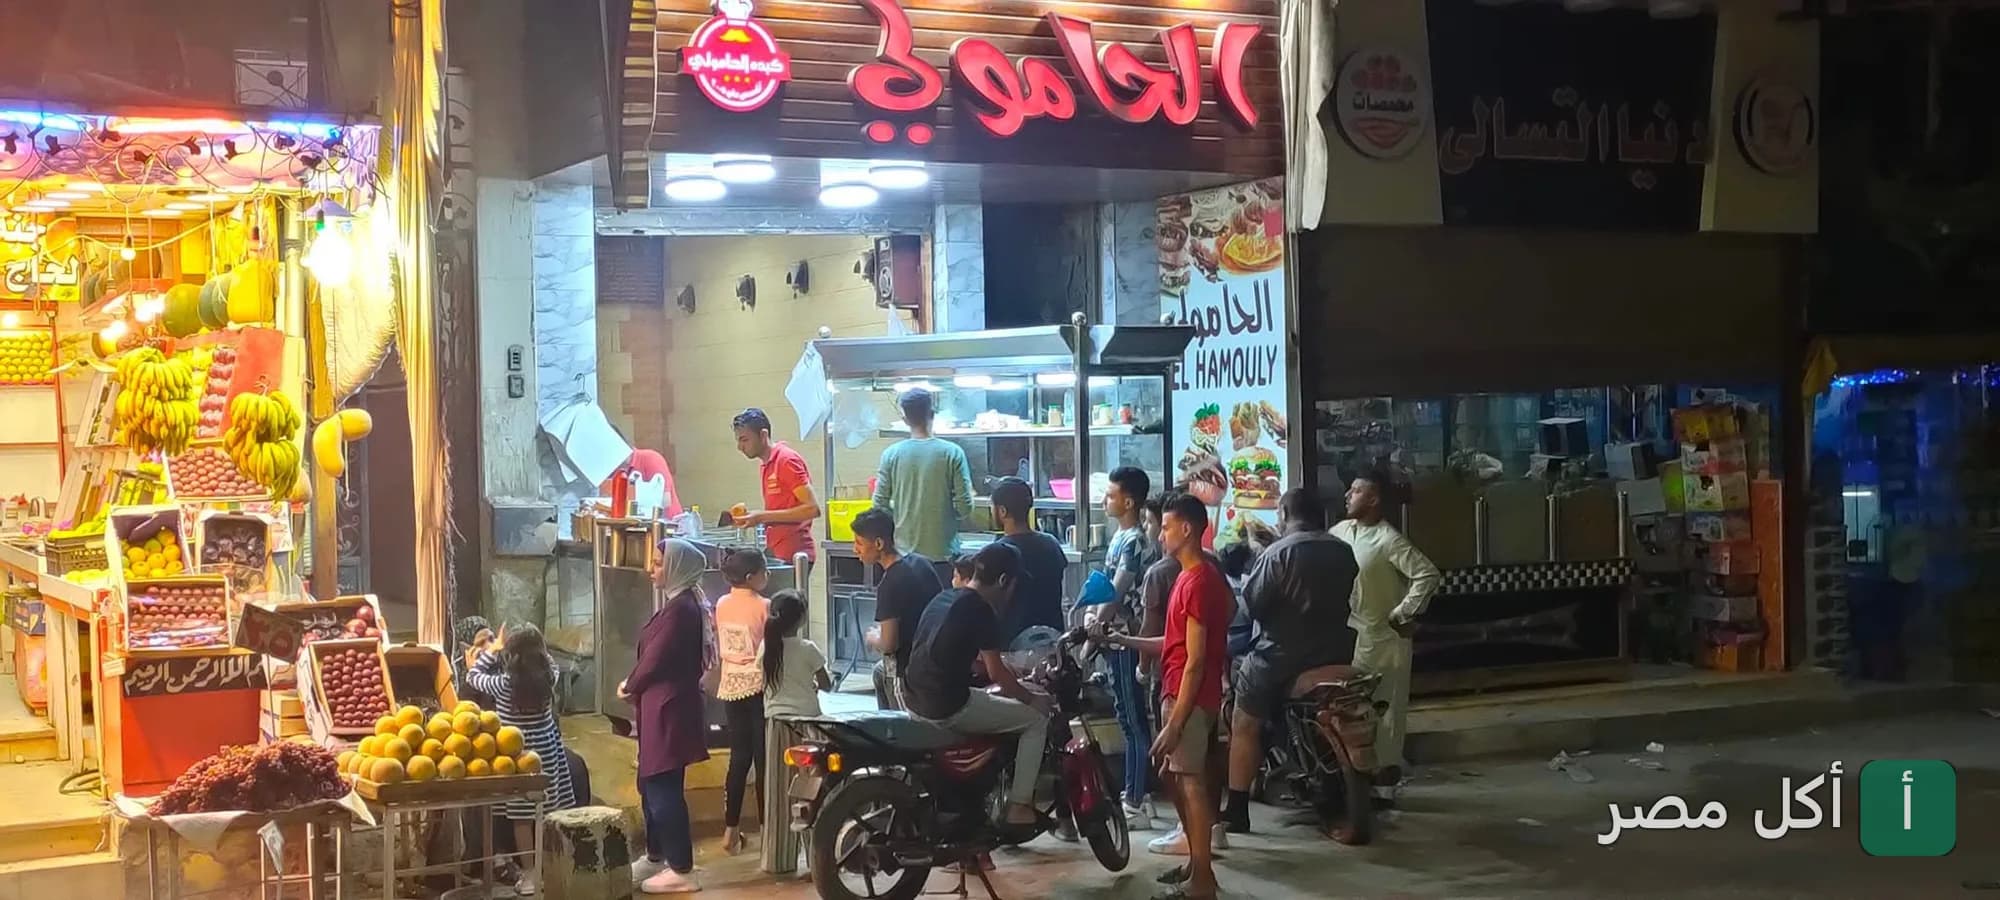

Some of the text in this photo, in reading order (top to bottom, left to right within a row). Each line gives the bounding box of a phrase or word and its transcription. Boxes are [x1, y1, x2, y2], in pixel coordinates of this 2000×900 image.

[847, 0, 1262, 145] الحامولي
[1178, 278, 1273, 348] الحامول
[1196, 345, 1278, 389] HAMOULY
